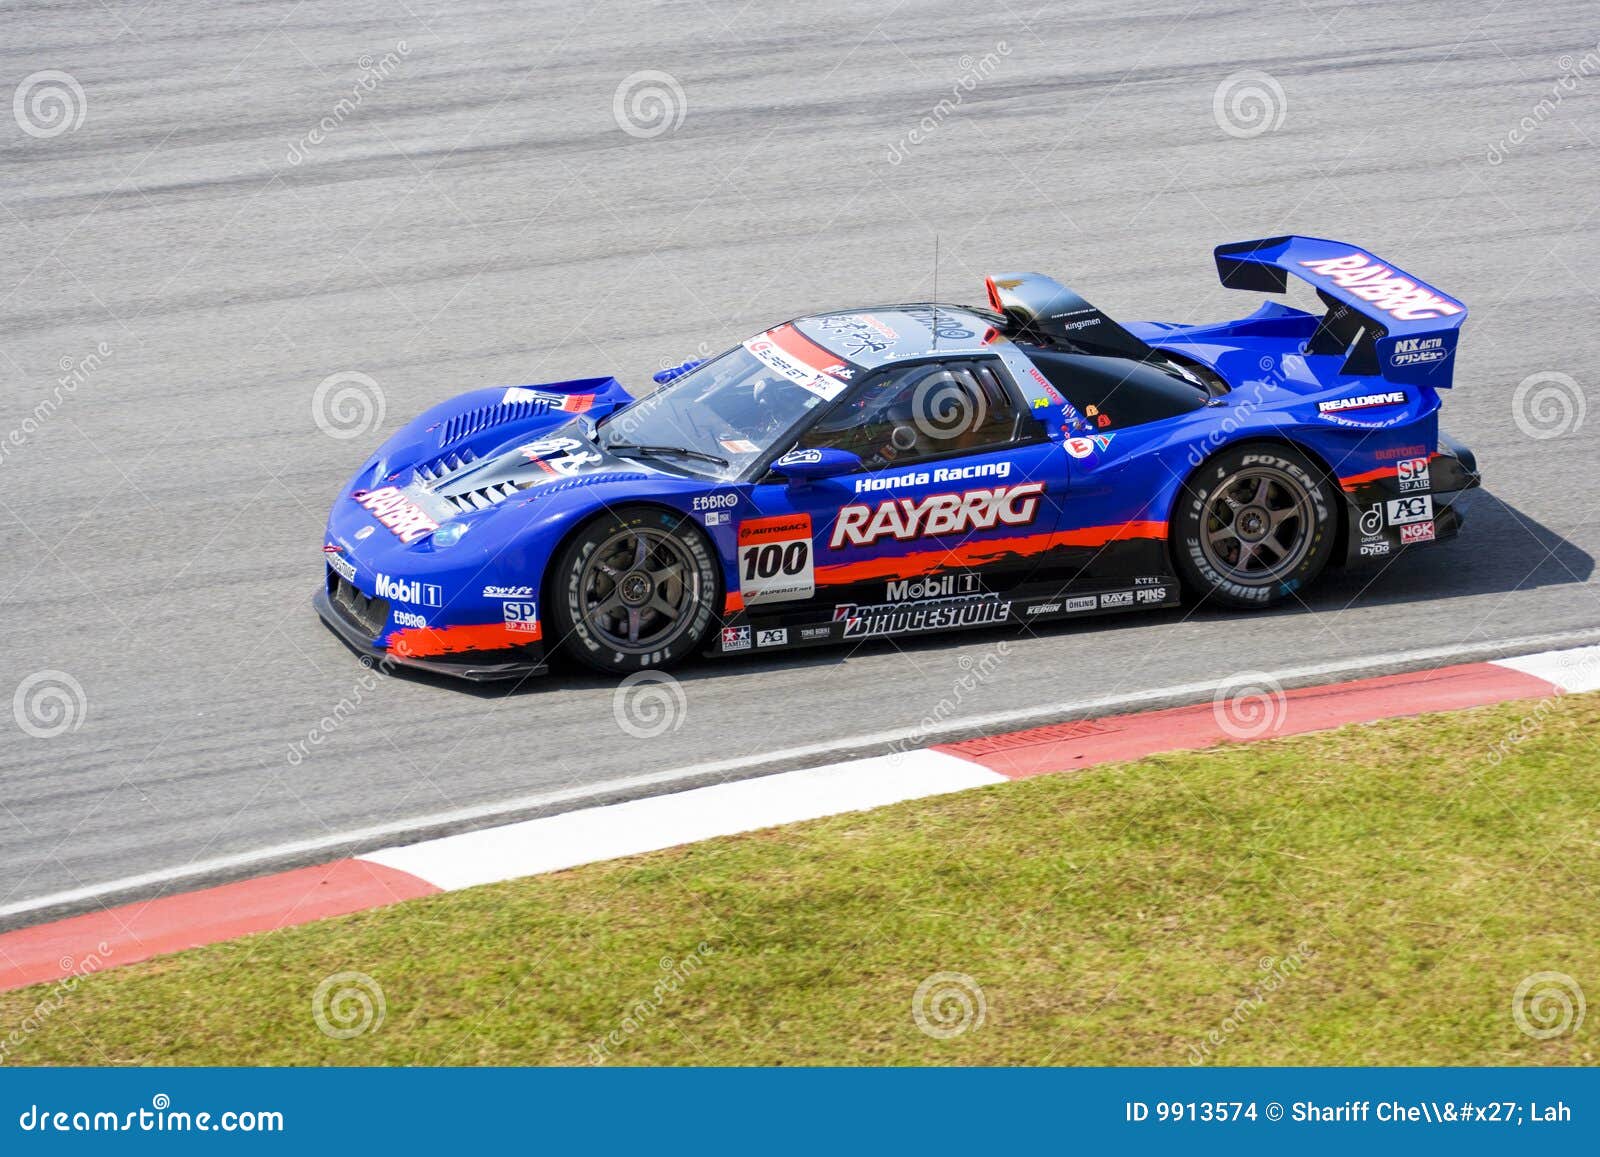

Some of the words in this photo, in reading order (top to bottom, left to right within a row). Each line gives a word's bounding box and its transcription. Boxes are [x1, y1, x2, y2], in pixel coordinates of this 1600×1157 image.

[1064, 317, 1101, 331] Kingsmen
[1394, 338, 1420, 354] NX
[1319, 391, 1405, 412] REALDRIVE
[855, 471, 931, 493] Honda
[934, 461, 1011, 486] Racing
[1399, 460, 1428, 481] SP
[693, 493, 738, 511] EBBRO
[1393, 497, 1427, 520] AG
[828, 481, 1047, 550] RAYBRIG
[751, 522, 808, 536] AUTOBACS
[1401, 521, 1434, 540] NGK
[1360, 544, 1390, 556] DyDo
[743, 541, 809, 581] 100
[375, 573, 421, 605] Mobil
[886, 575, 954, 601] Mobil
[1136, 587, 1167, 601] PINS
[394, 610, 427, 629] EBBRO
[505, 602, 535, 622] SP
[843, 601, 1012, 639] BRIDGESTONE
[761, 630, 784, 644] AG
